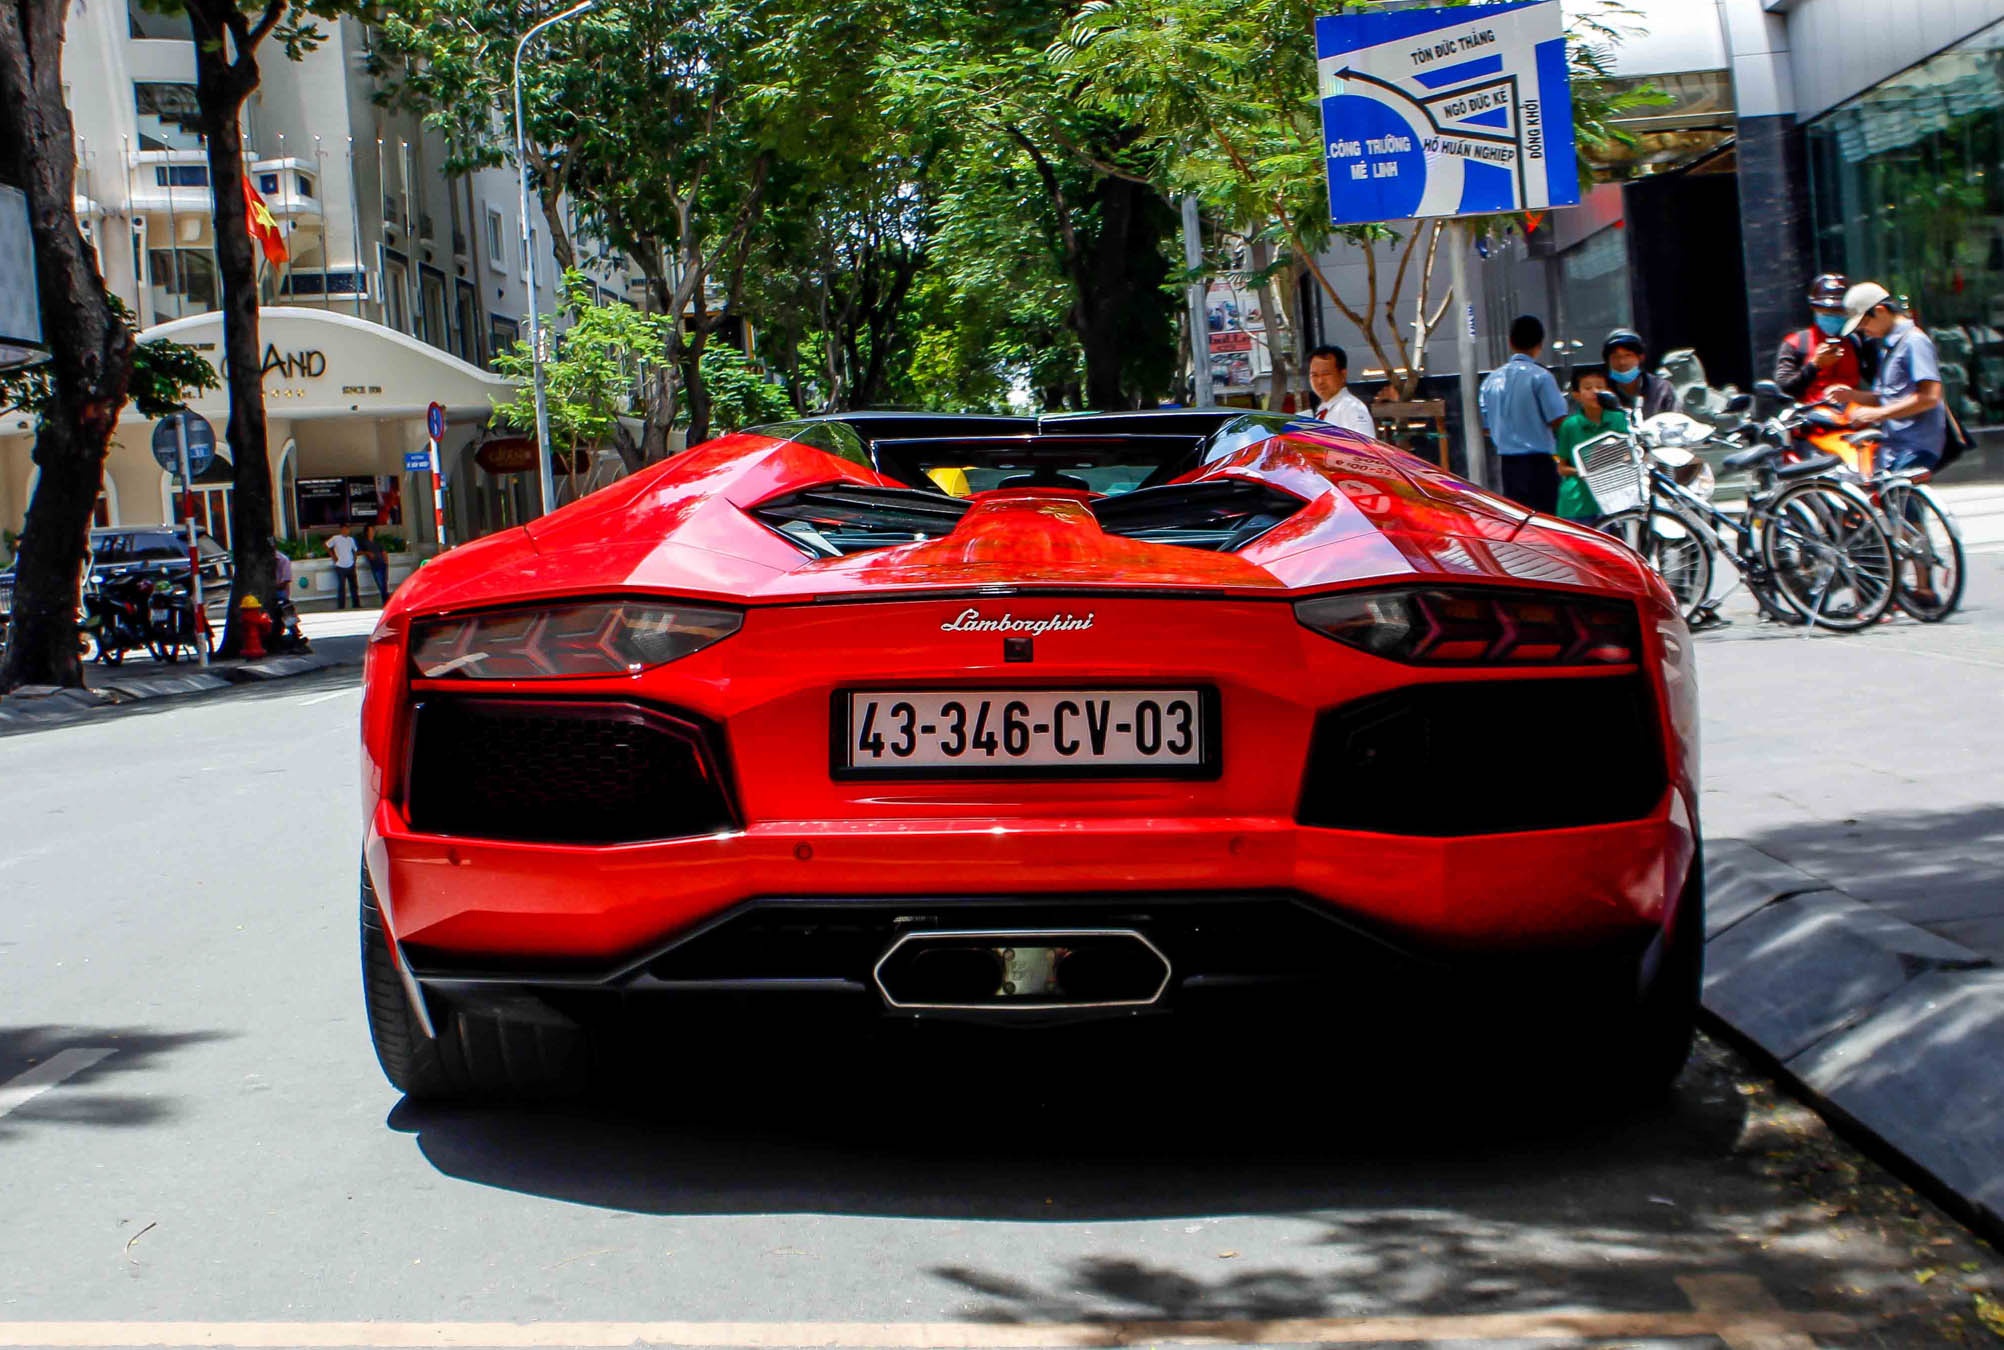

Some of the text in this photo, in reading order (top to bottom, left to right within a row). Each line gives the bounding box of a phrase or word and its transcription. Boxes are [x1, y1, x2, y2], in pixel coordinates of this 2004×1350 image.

[1330, 138, 1362, 158] CÔNG
[1372, 161, 1398, 178] LINH
[940, 608, 1094, 636] Lamborghini
[858, 700, 1194, 758] 43-346-CV-03
